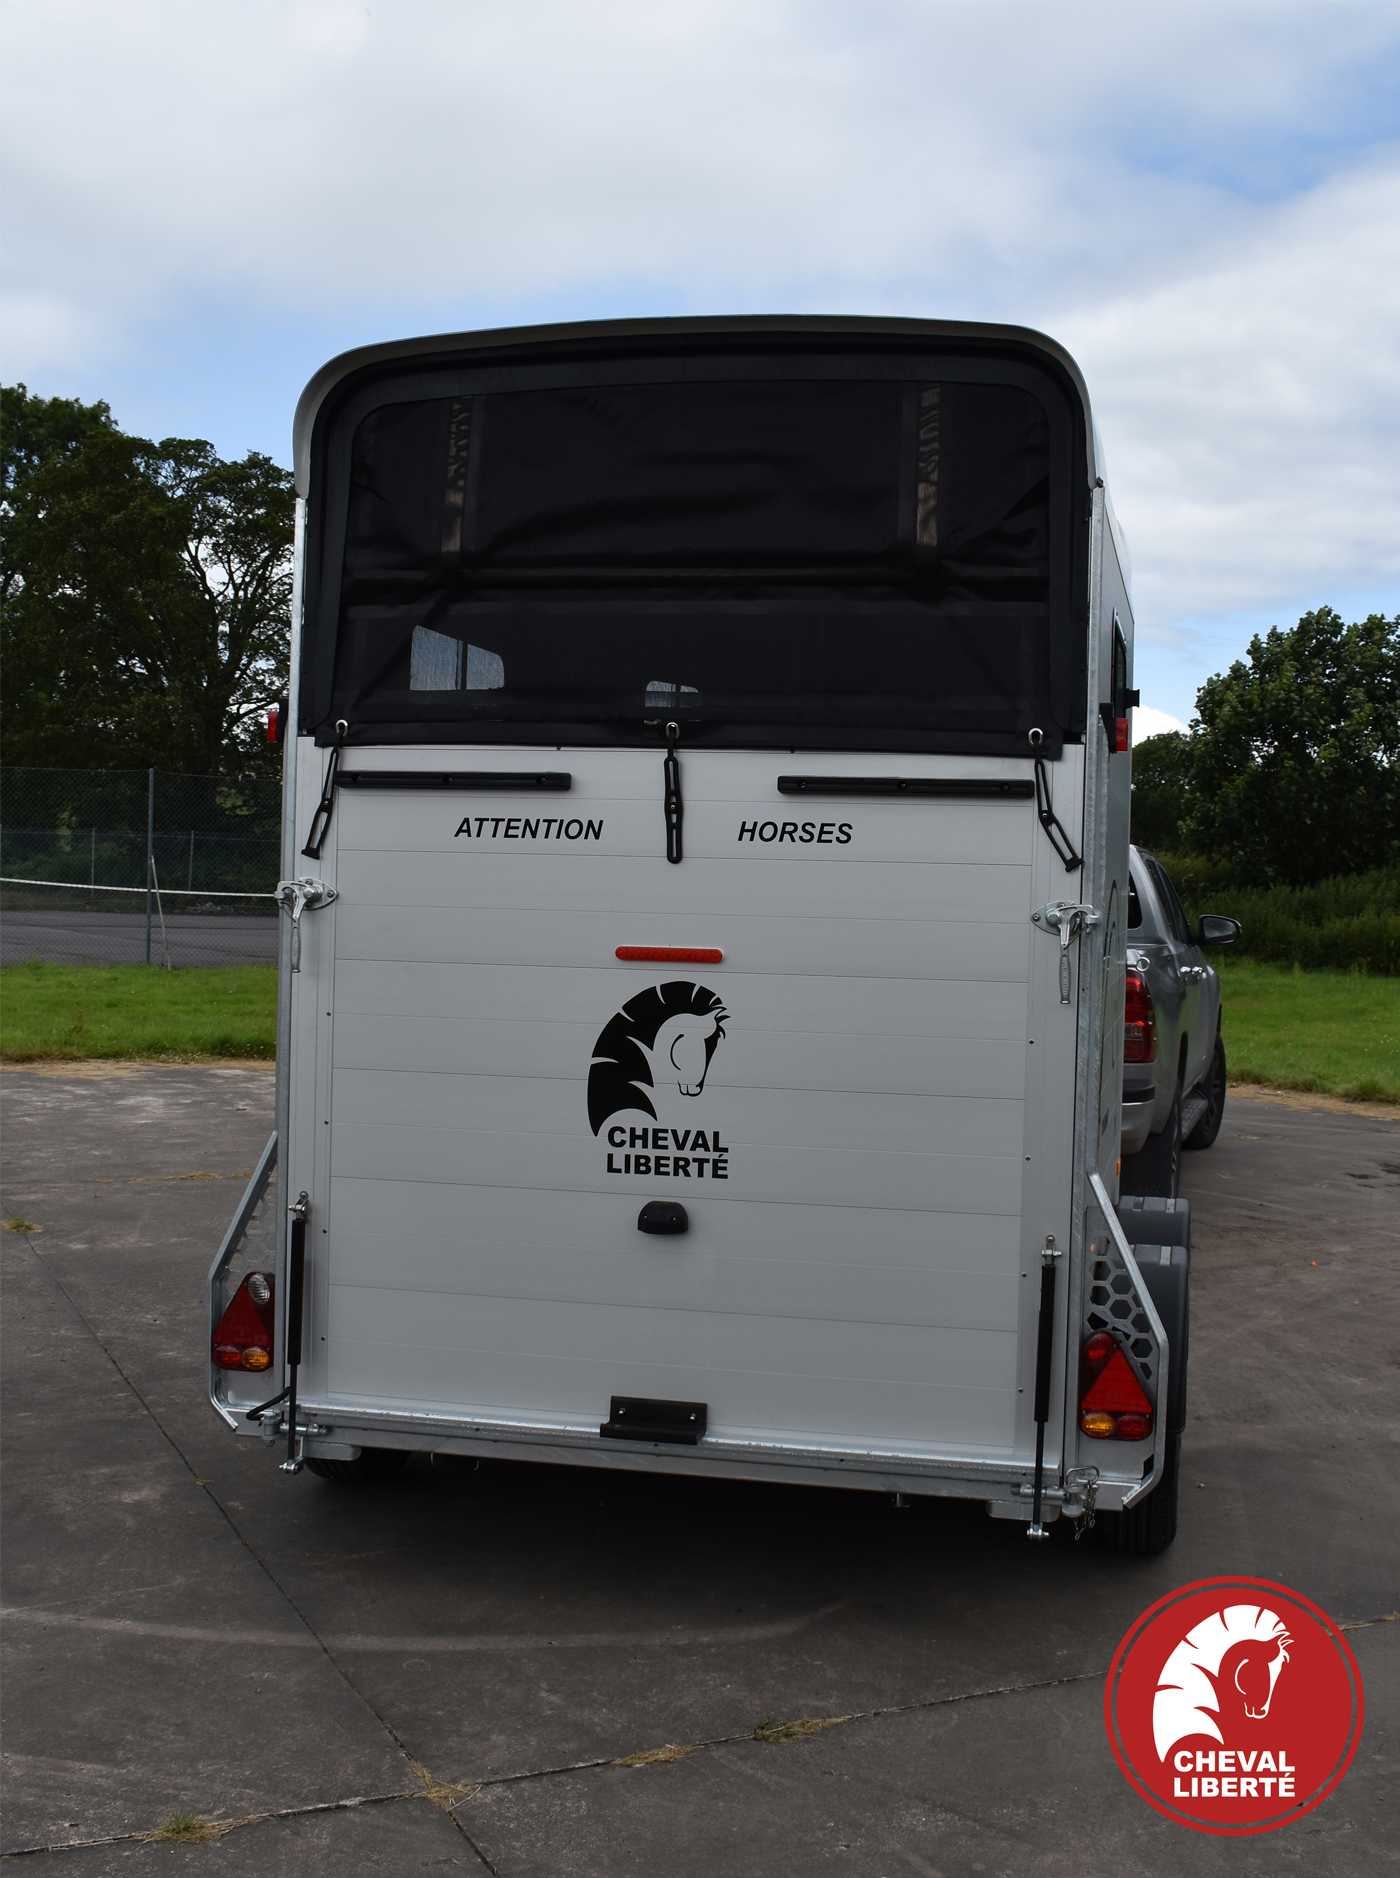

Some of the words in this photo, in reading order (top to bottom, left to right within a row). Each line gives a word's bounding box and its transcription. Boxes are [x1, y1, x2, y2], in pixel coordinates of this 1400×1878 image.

[454, 818, 603, 840] ATTENTION
[738, 821, 853, 844] HORSES
[607, 1126, 729, 1153] CHEVAL
[607, 1153, 729, 1179] LIBERTÉ
